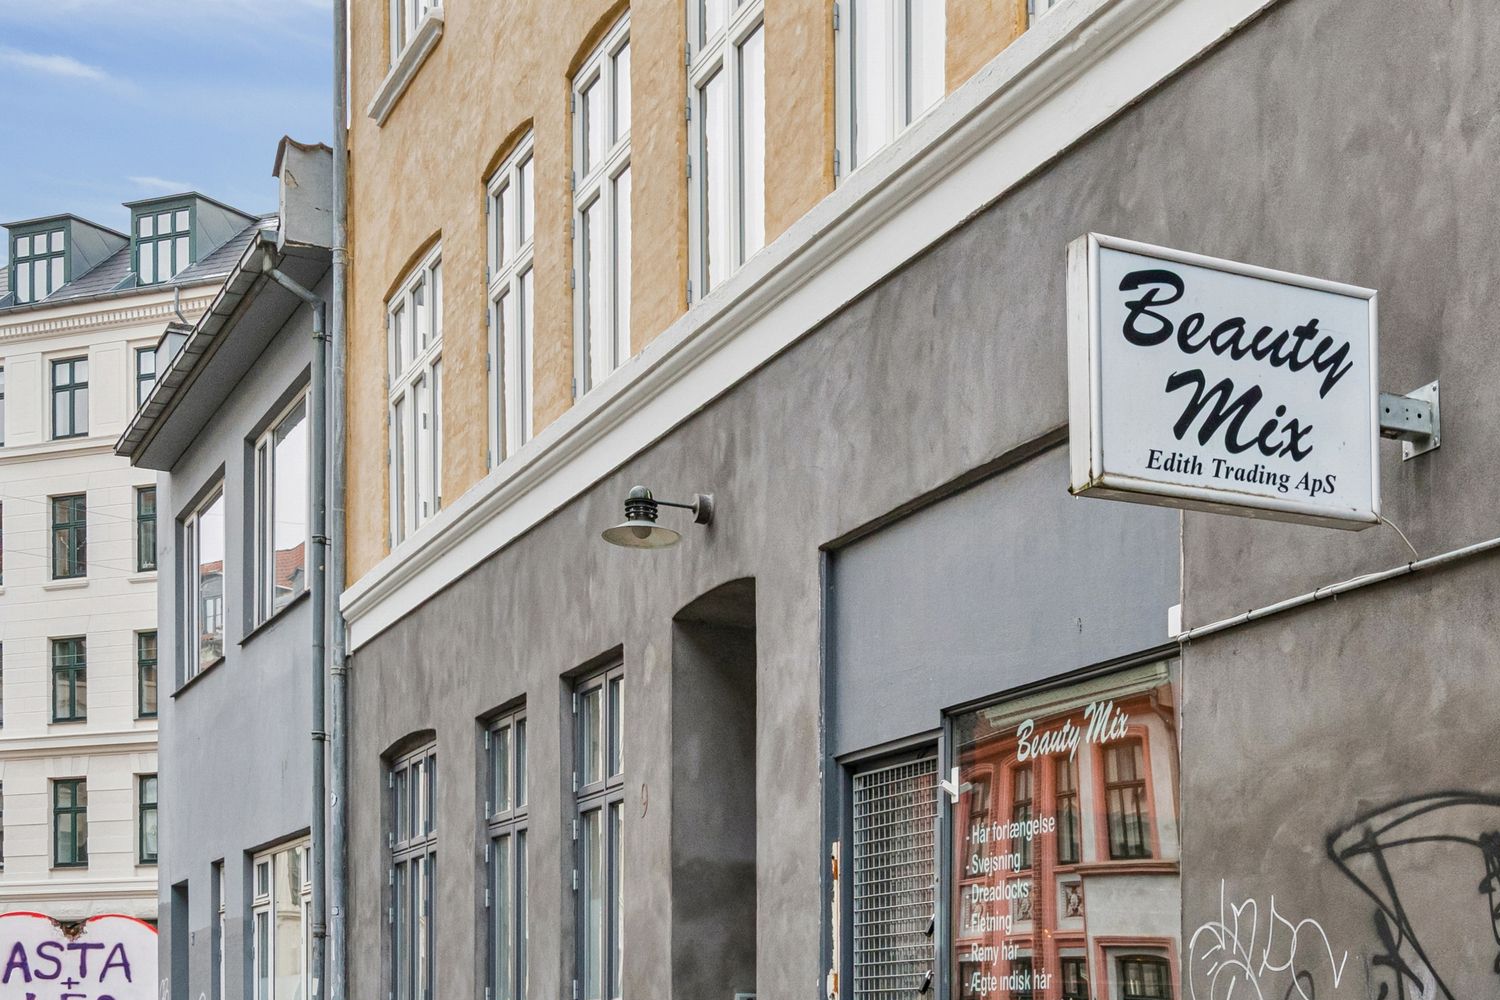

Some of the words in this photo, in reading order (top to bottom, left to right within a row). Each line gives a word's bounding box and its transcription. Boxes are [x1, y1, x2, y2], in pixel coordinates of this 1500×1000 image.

[1119, 269, 1353, 399] Beauty
[1165, 369, 1313, 462] Mix
[1145, 448, 1203, 475] Edith
[1212, 458, 1291, 493] Trading
[1296, 471, 1337, 496] ApS
[1016, 719, 1081, 763] Beauty
[1084, 701, 1129, 744] Mix
[972, 823, 990, 845] Hår
[992, 813, 1056, 841] forlængelse
[971, 850, 1020, 876] Svejsning
[971, 878, 1029, 903] Dreadlocks
[971, 911, 1012, 935] Fletning
[2, 941, 132, 983] ASTA
[971, 943, 999, 966] Remy
[1001, 939, 1019, 960] hår
[971, 972, 997, 996] Ægte
[1000, 969, 1031, 991] indisk
[1033, 968, 1052, 989] hår
